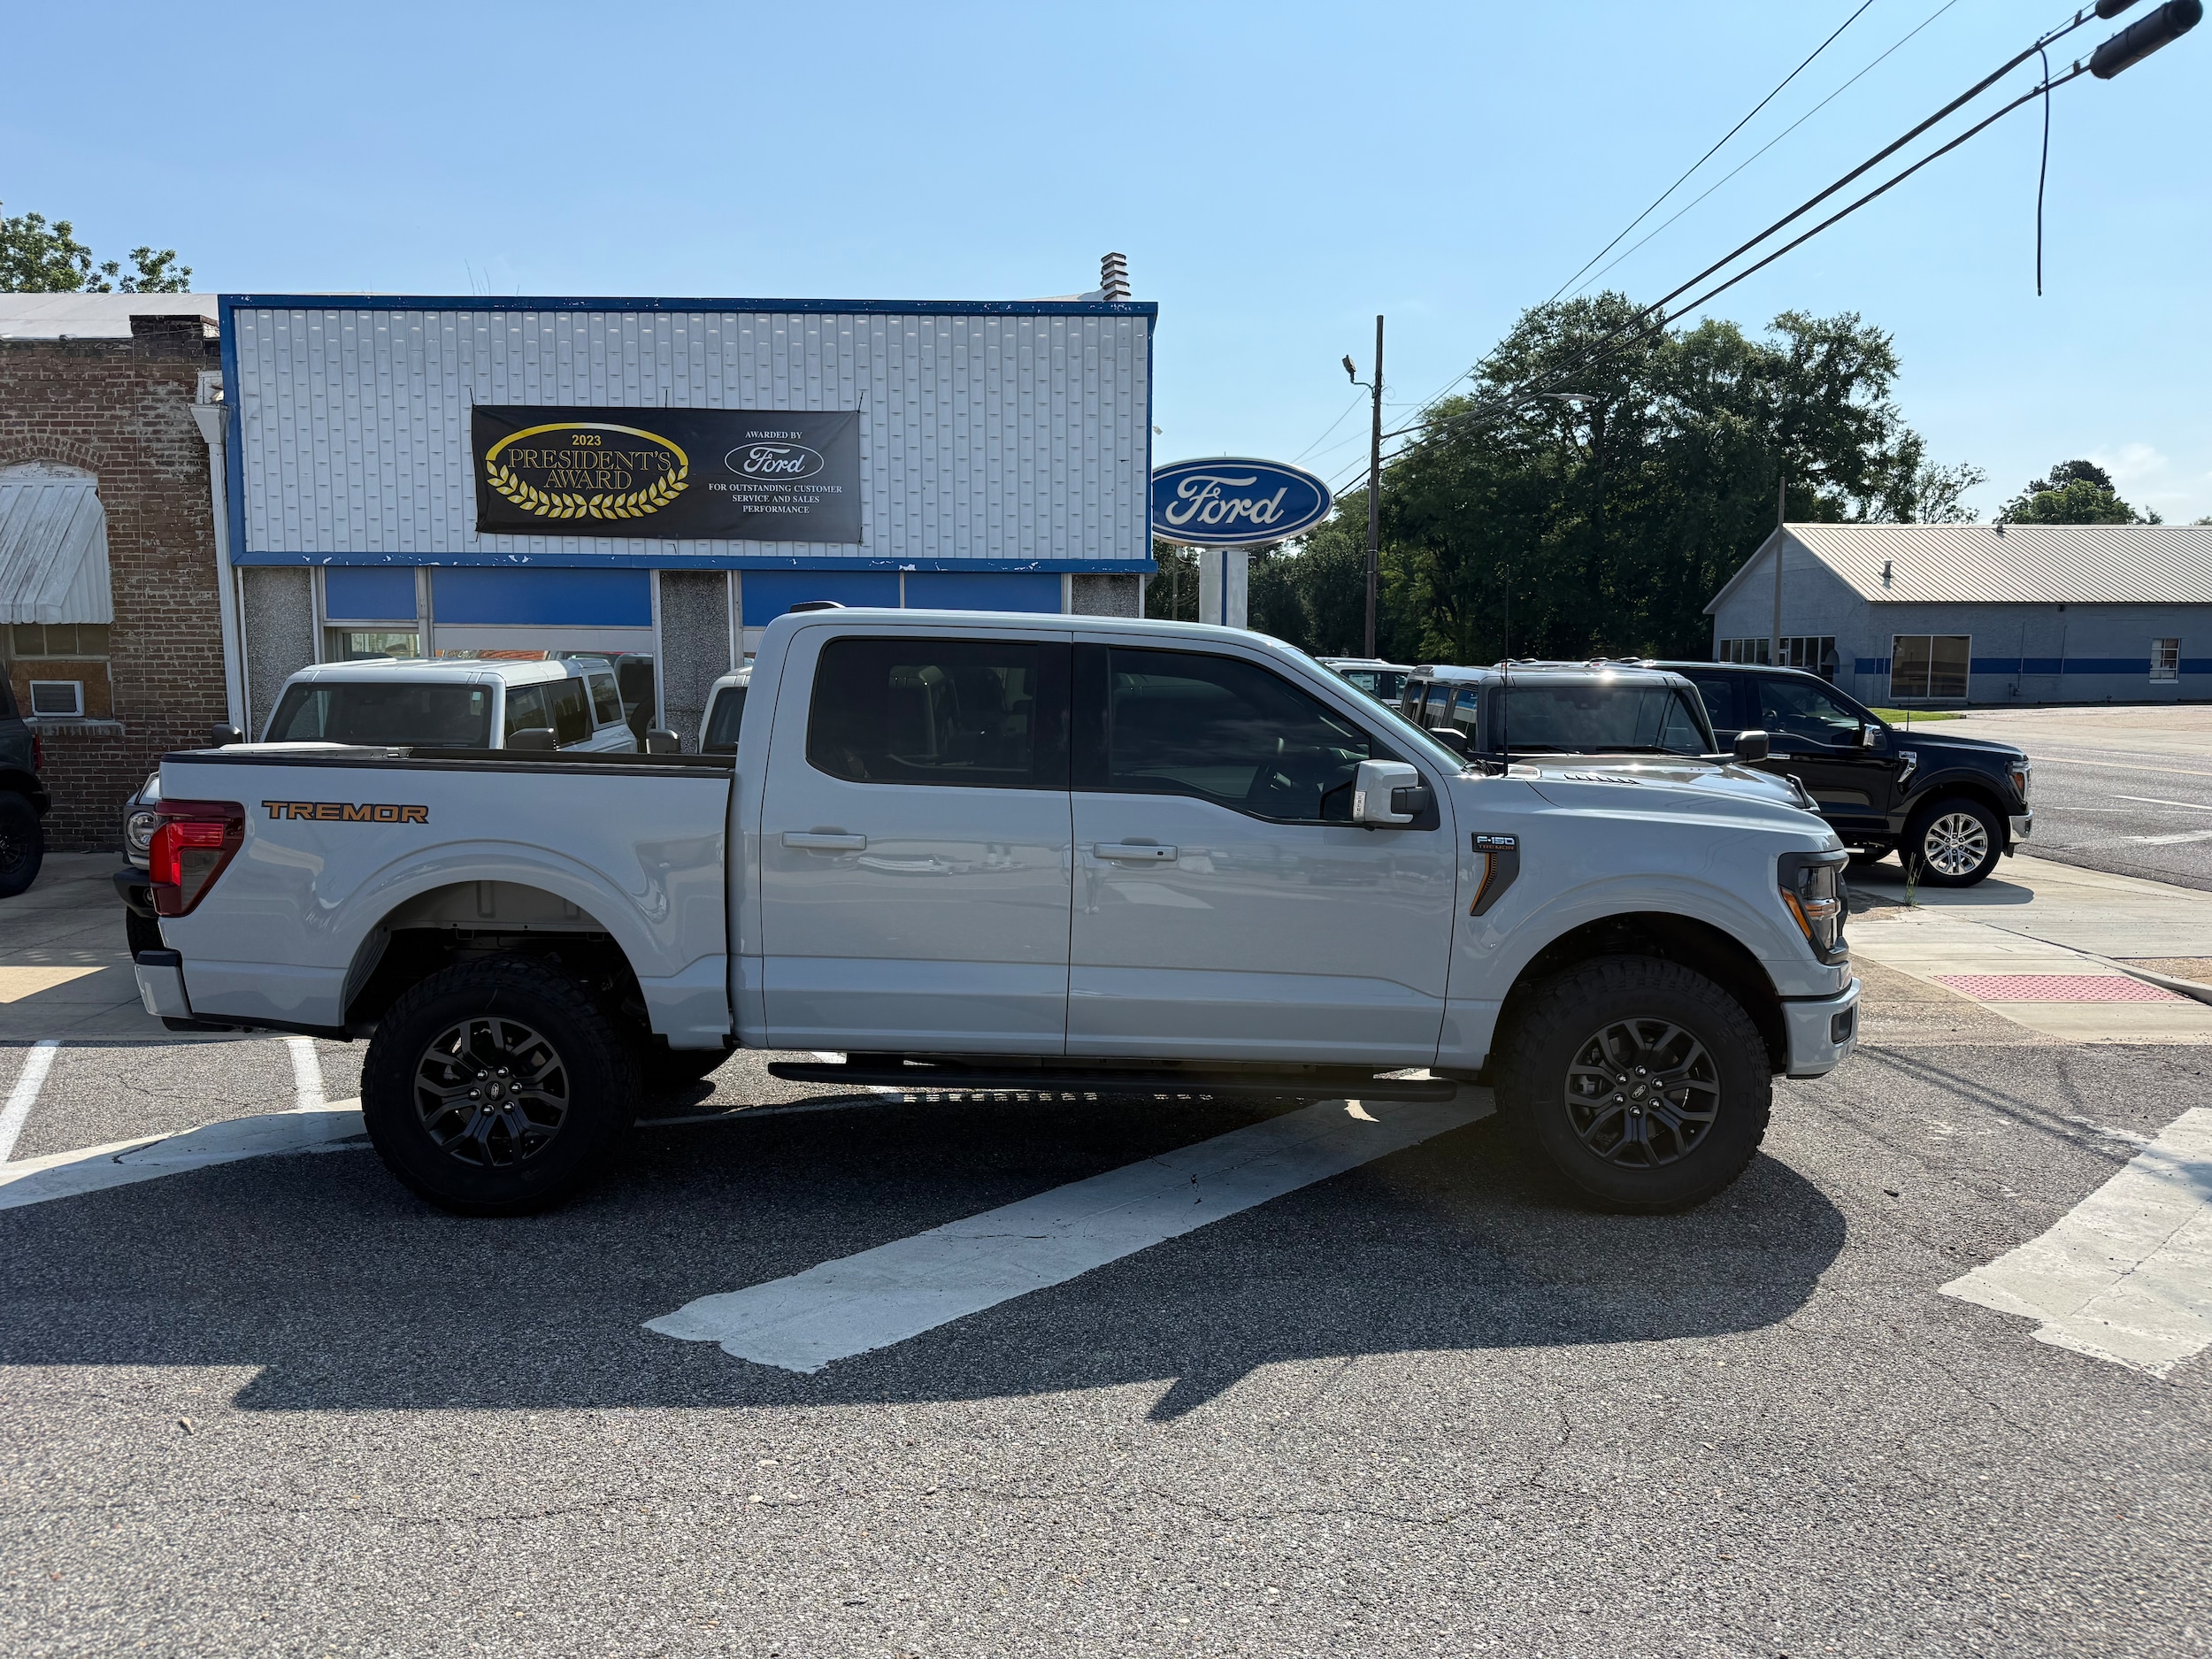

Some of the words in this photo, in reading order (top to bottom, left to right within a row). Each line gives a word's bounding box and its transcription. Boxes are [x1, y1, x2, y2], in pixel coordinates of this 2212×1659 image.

[572, 434, 602, 446] 2023
[508, 449, 672, 471] PRESIDENT'S
[743, 447, 805, 473] Ford
[543, 469, 633, 489] AWARD
[1165, 475, 1288, 526] Ford
[261, 800, 429, 825] TREMOR
[1477, 835, 1515, 845] F-150
